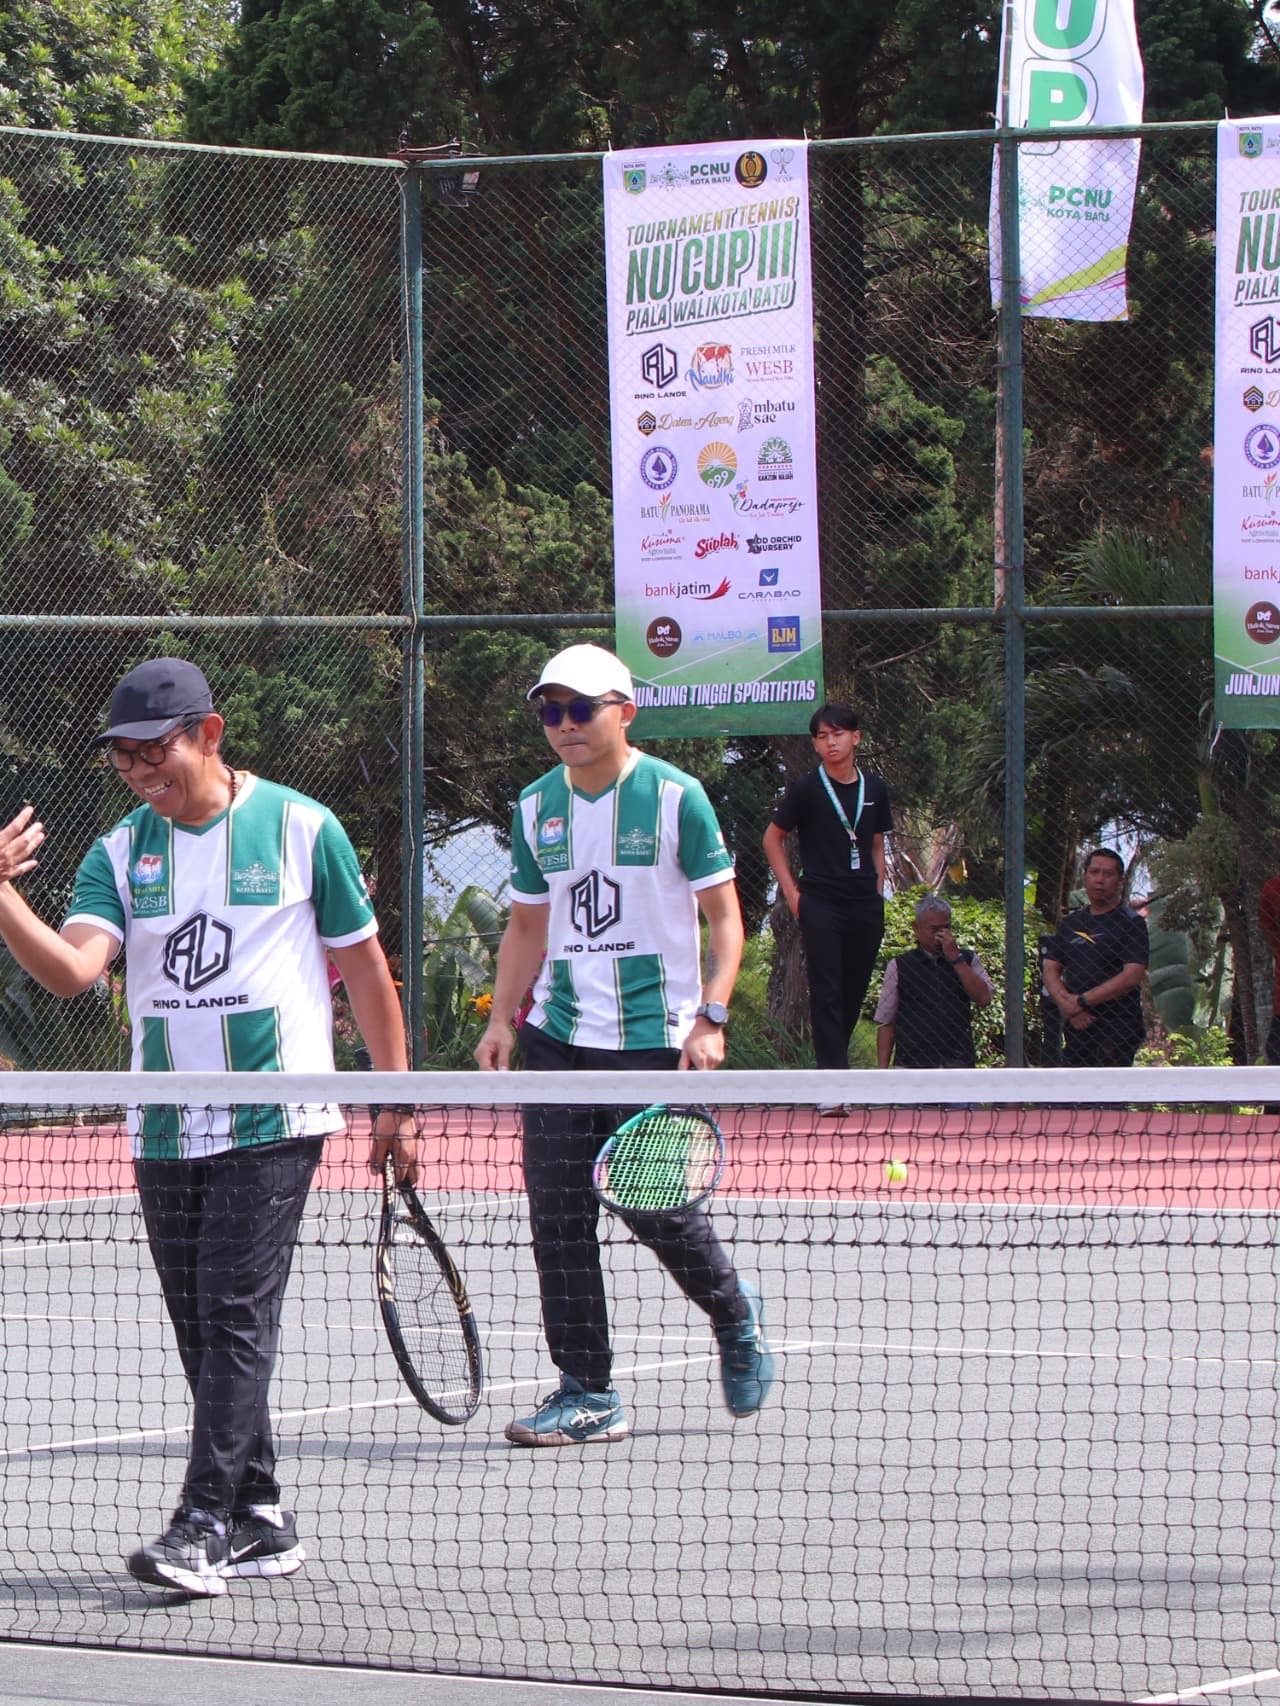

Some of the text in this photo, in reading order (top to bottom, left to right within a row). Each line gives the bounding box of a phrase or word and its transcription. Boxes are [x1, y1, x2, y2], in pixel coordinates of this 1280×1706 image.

[690, 162, 730, 176] PCNU
[690, 176, 731, 186] KOTA BATU
[1049, 185, 1112, 208] PCNU
[627, 197, 797, 247] TOURNAMENT TENNIS
[1047, 209, 1110, 222] KOTA BATU
[626, 221, 794, 305] NU CUP III
[626, 280, 791, 331] PIALA WALIKOTA BATU
[746, 359, 793, 376] WESB
[657, 391, 687, 399] LANDE
[754, 400, 795, 413] mbatu
[754, 413, 777, 424] sae
[1242, 486, 1264, 498] BATU
[640, 503, 710, 519] BATU PANORAMA
[770, 535, 802, 543] ORCHID
[758, 543, 794, 552] NURSERY
[645, 582, 711, 599] bankjatim
[738, 589, 801, 600] CARABAO
[772, 627, 796, 643] BJM
[690, 683, 731, 706] TINGGI
[735, 680, 816, 703] SPORTIFITAS
[587, 941, 636, 953] LANDE
[152, 994, 249, 1009] RINO LANDE
